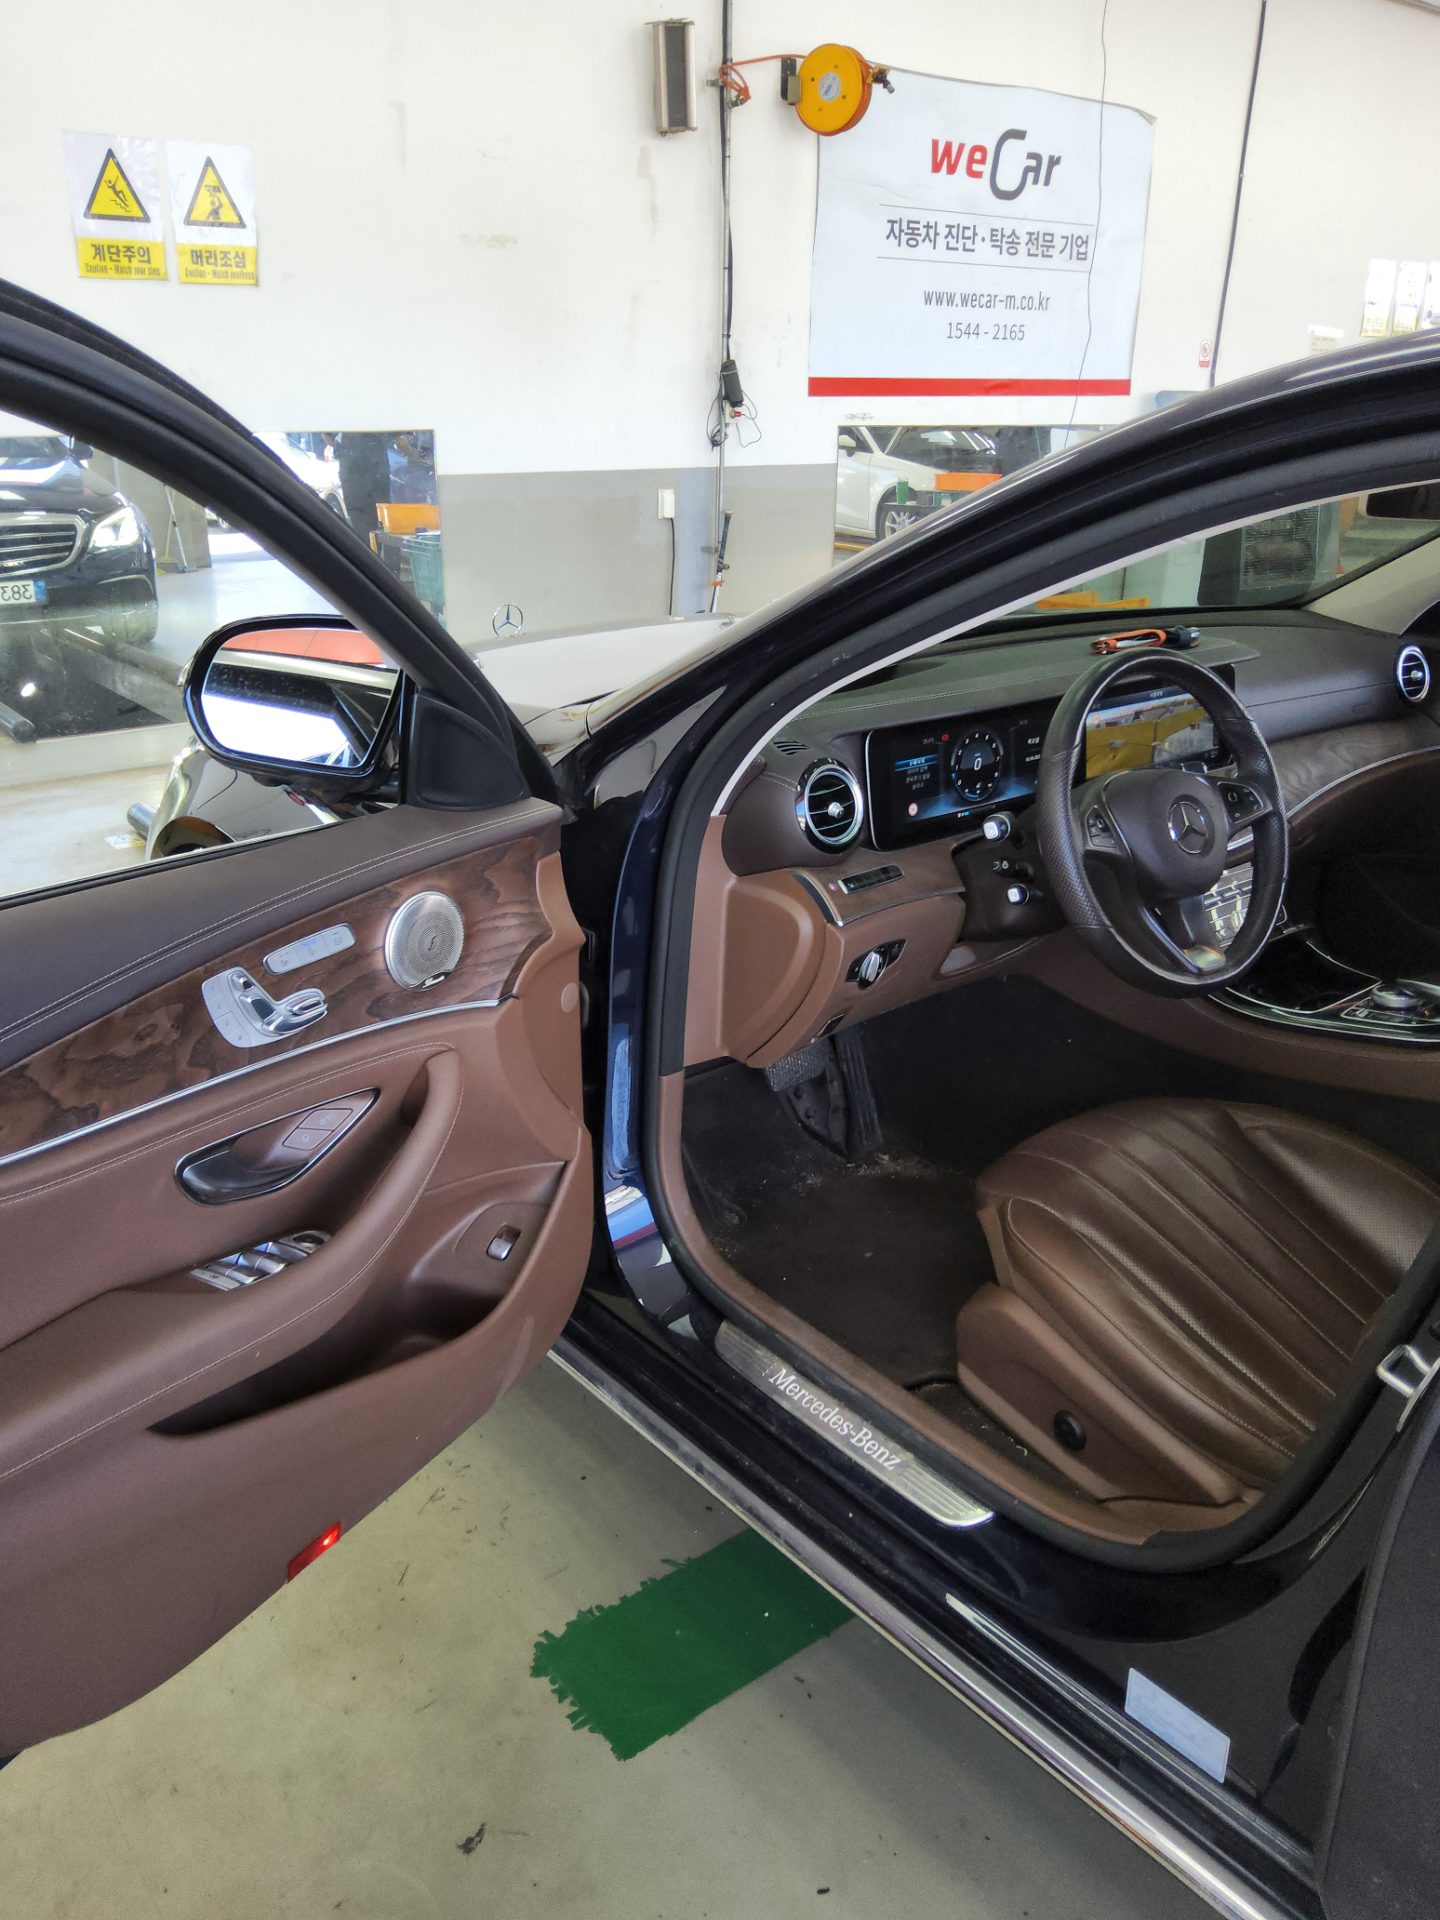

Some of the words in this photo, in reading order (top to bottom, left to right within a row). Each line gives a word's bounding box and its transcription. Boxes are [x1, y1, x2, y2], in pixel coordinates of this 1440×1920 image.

[931, 128, 1062, 201] weCar
[91, 243, 152, 265] 계단주의
[885, 217, 940, 250] 자동차
[1025, 230, 1056, 259] 전문
[1059, 233, 1090, 262] 기업
[190, 248, 247, 269] 머리조심
[923, 289, 1051, 312] www.wecar-m.co.kr
[768, 1368, 902, 1471] Mercedes-Benz
